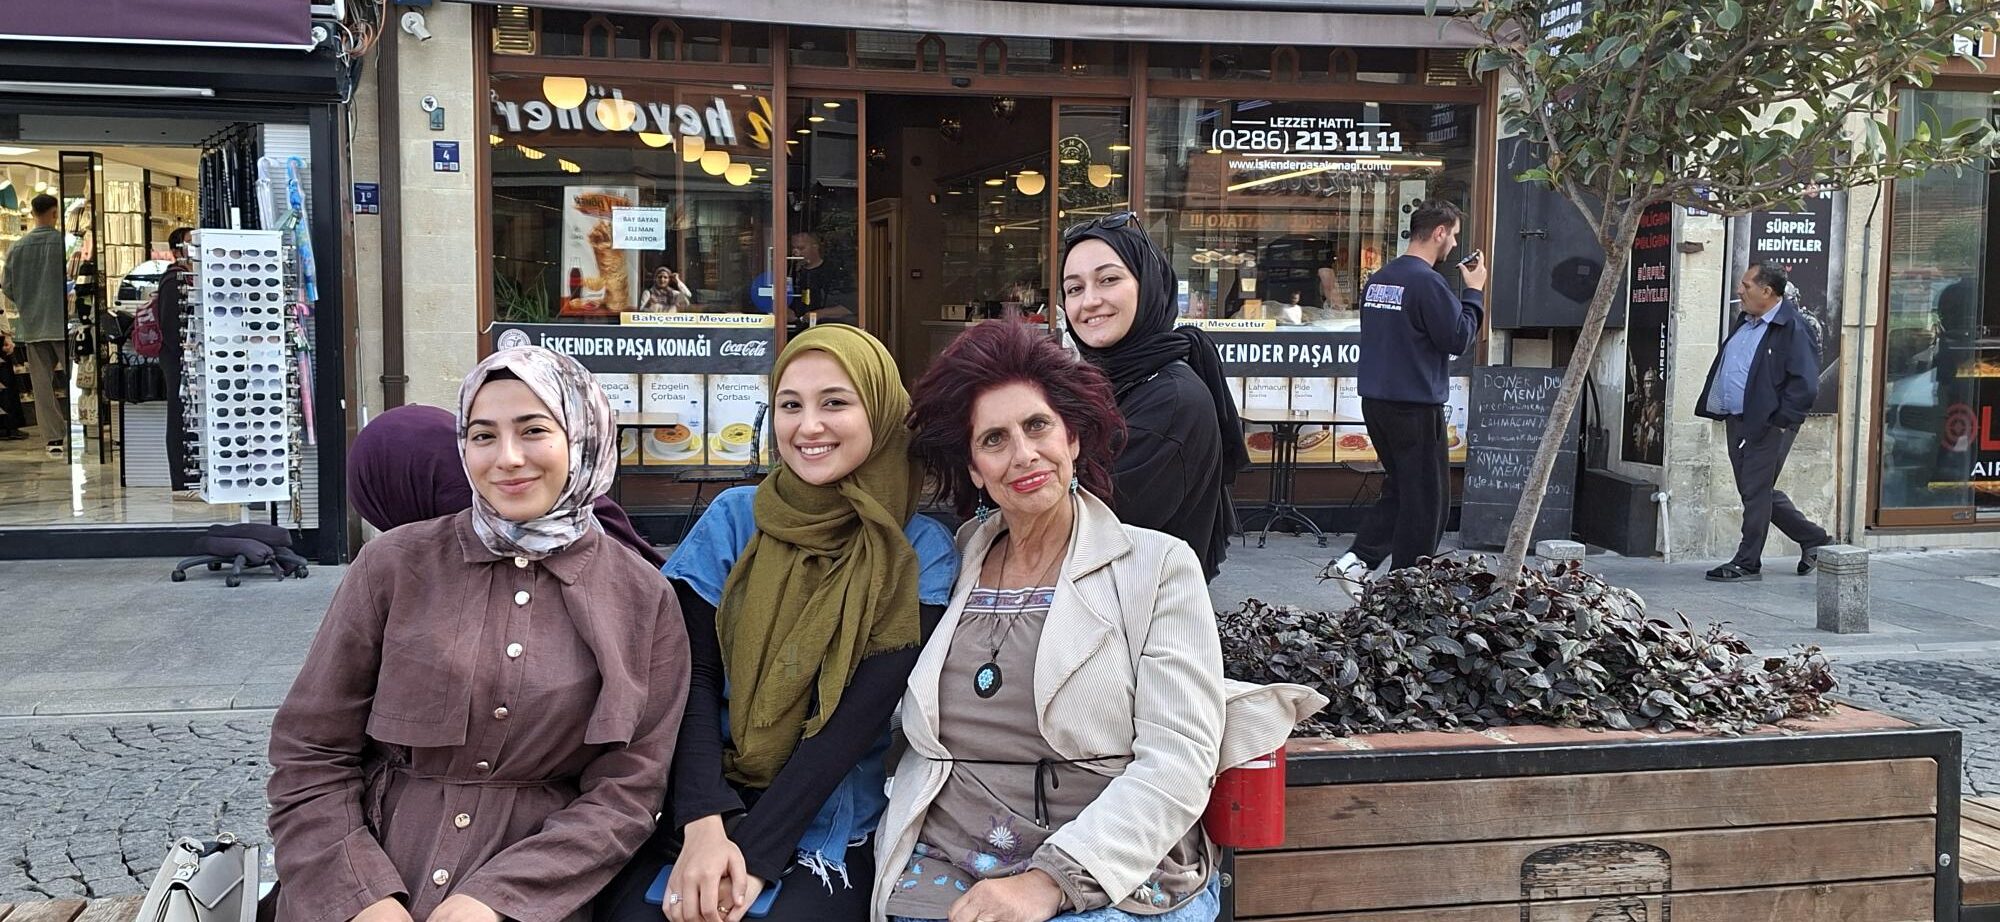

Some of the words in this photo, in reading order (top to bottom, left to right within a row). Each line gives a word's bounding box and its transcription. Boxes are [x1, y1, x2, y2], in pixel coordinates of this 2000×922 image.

[1270, 117, 1316, 128] LEZZET
[1319, 118, 1354, 129] HATTI
[1212, 129, 1289, 154] (0286)
[1295, 130, 1338, 151] 213
[1346, 131, 1372, 152] 11
[1377, 131, 1403, 152] 11
[443, 150, 450, 160] 4
[1229, 159, 1392, 172] www.iskenderpasaknagi.com.tr
[1766, 218, 1816, 235] SÜRPRİZ
[1757, 235, 1822, 252] HEDİYELER
[1637, 262, 1666, 281] SÜRPRİZ
[1632, 285, 1669, 303] HEDİYELER
[632, 313, 695, 323] Bahçemiz
[699, 314, 763, 323] Mevcuttur
[1207, 320, 1266, 328] Mevcuttur
[540, 332, 614, 356] İSKENDER
[616, 338, 655, 360] PAŞA
[657, 333, 711, 357] KONAĞI
[720, 339, 769, 356] Coca-Cola
[1216, 344, 1284, 363] KENDER
[1288, 344, 1333, 368] PAŞA
[651, 382, 689, 391] Ezogelin
[716, 383, 760, 391] Mercimek
[1248, 383, 1287, 391] Lahmacun
[1294, 383, 1311, 391] Pide
[651, 392, 686, 401] Çorbası
[716, 393, 751, 402] Çorbası
